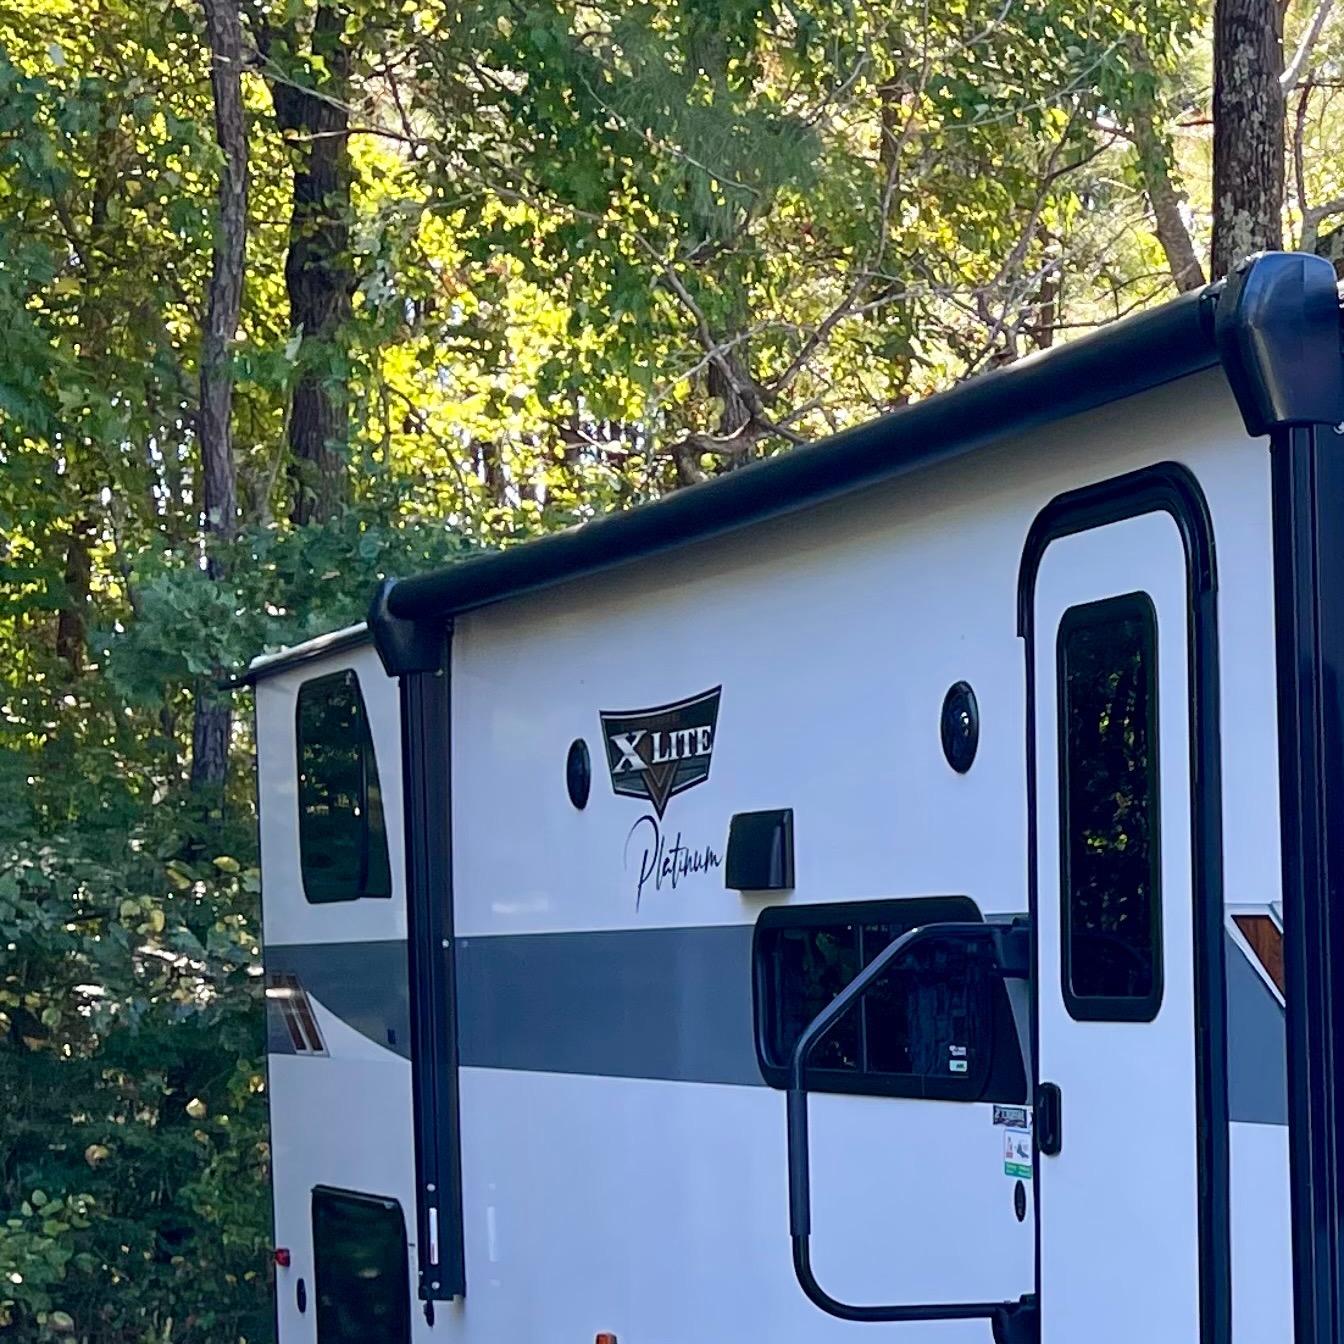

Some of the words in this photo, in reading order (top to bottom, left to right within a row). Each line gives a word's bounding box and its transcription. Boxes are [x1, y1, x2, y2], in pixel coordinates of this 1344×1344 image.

[610, 729, 649, 774] X
[651, 725, 712, 764] LITE
[622, 814, 724, 914] Platinum
